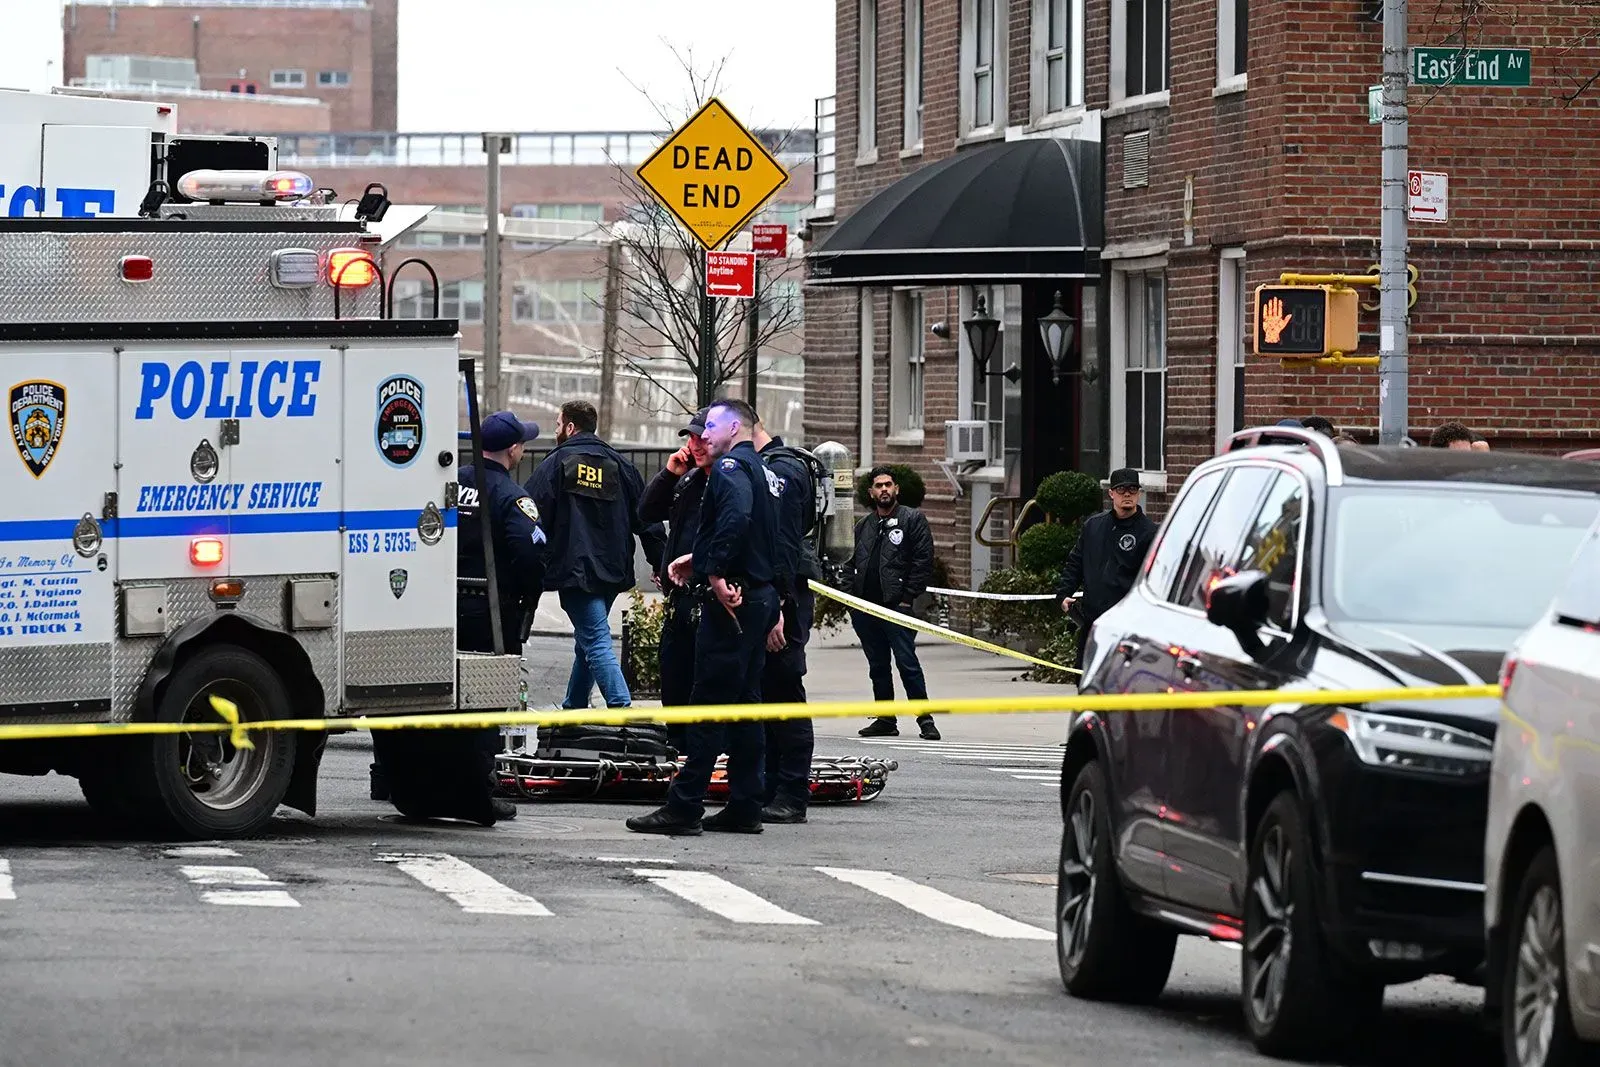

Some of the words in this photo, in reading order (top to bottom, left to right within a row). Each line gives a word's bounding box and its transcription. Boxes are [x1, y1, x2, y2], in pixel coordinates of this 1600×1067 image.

[1418, 53, 1456, 80] East
[1465, 53, 1499, 80] End
[1508, 53, 1522, 68] Av
[673, 146, 752, 171] DEAD
[684, 184, 740, 208] END
[709, 256, 717, 264] NO
[719, 256, 748, 266] STANDING
[709, 266, 734, 276] Anytime
[23, 385, 53, 396] POLICE
[135, 360, 321, 420] POLICE
[381, 380, 421, 404] POLICE
[12, 395, 64, 413] DEPARTMENT
[383, 400, 419, 421] EMERGENCY
[14, 424, 24, 446] CITY
[22, 450, 32, 461] OF
[42, 446, 54, 466] NEW
[53, 418, 64, 442] YORK
[578, 463, 602, 482] FBI
[136, 484, 245, 512] EMERGENCY
[248, 482, 322, 509] SERVICE
[349, 533, 368, 553] ESS
[373, 532, 379, 552] 2
[384, 532, 411, 552] 5735
[0, 556, 12, 568] In
[18, 556, 56, 570] Memory
[60, 554, 75, 567] Of
[1, 580, 17, 588] gt.
[41, 577, 78, 586] Curtin
[20, 590, 28, 598] J.
[35, 589, 82, 598] Vigiano
[24, 600, 78, 608] J.Dallara
[15, 613, 21, 622] J.
[26, 610, 80, 621] McCormack
[0, 626, 13, 636] SS
[21, 623, 66, 634] TRUCK
[74, 623, 82, 632] 2
